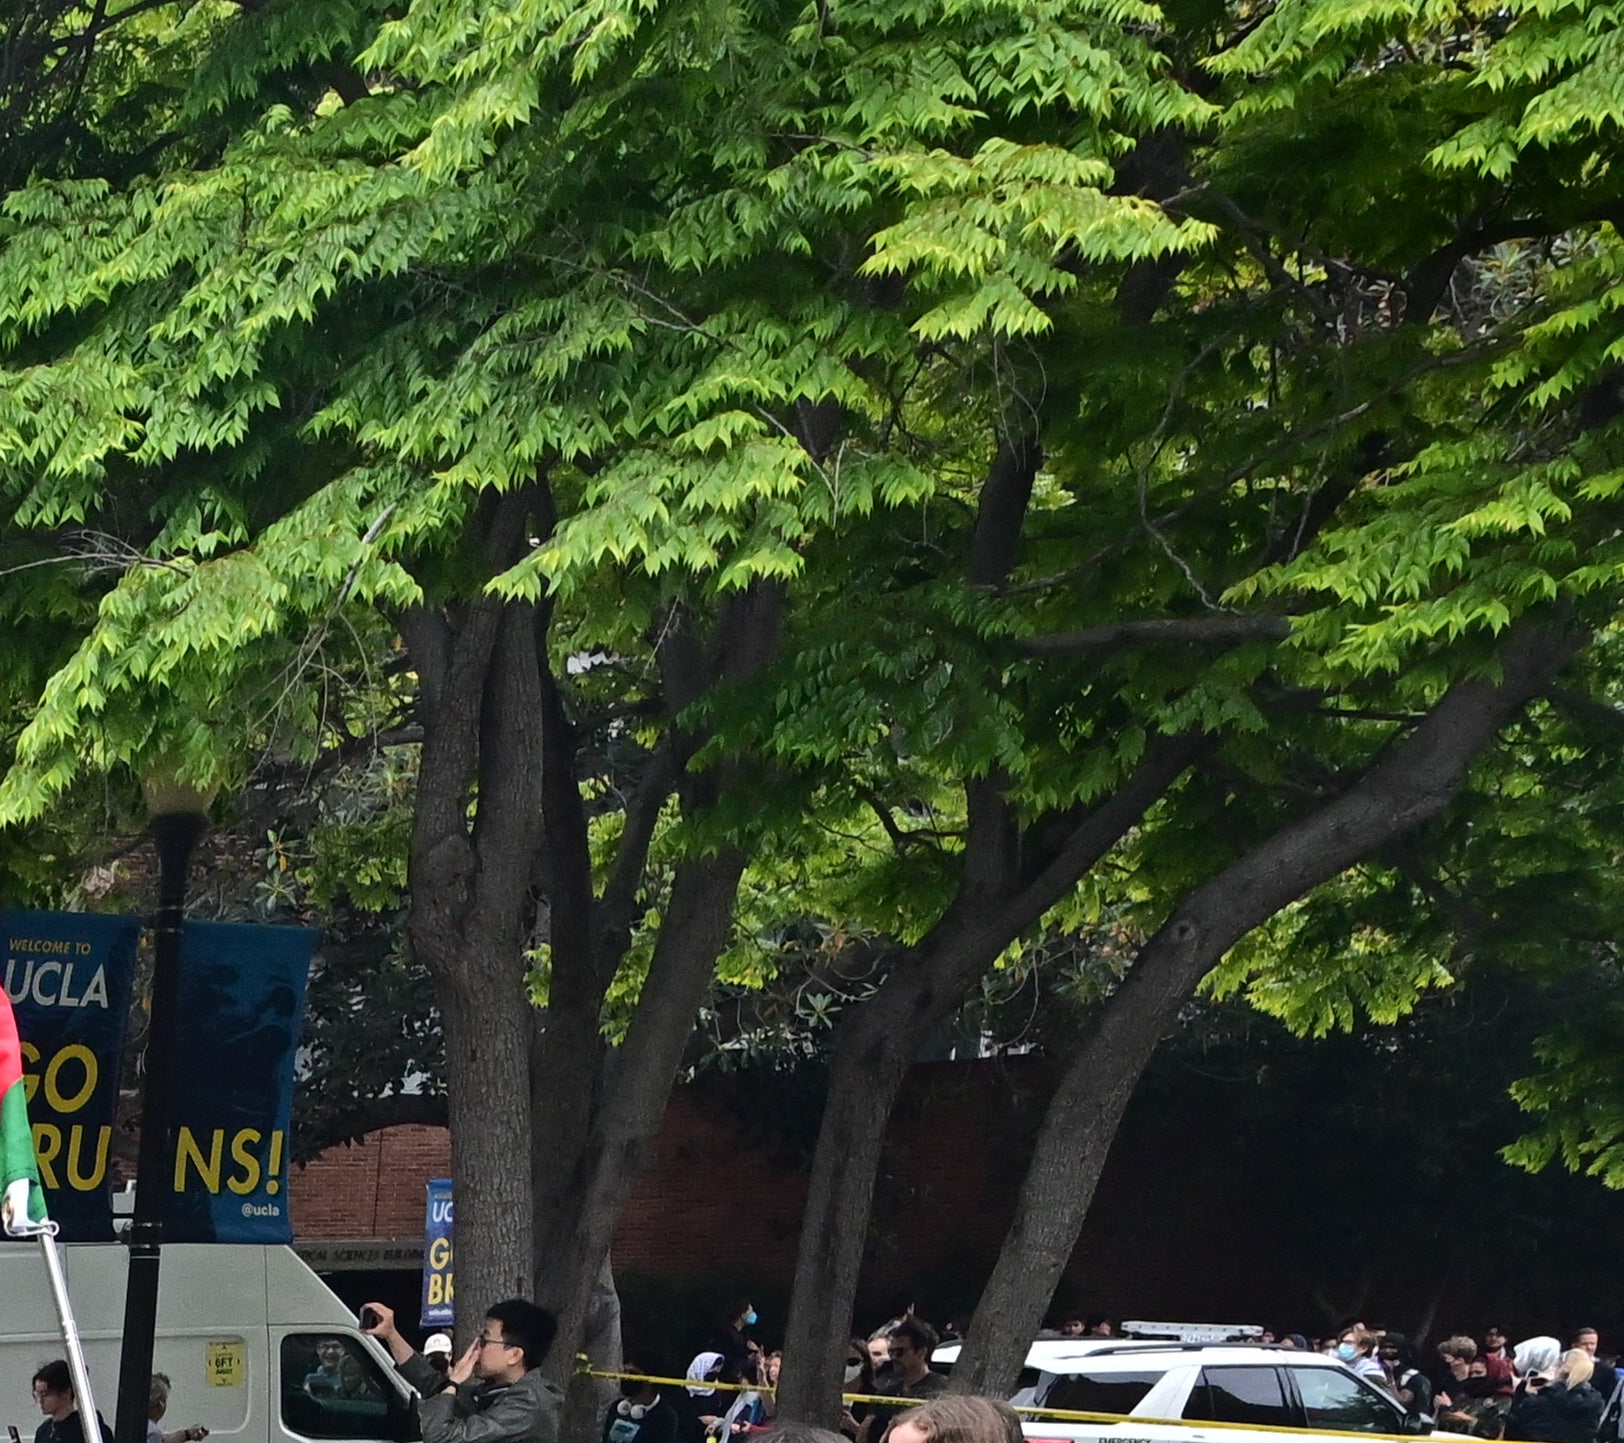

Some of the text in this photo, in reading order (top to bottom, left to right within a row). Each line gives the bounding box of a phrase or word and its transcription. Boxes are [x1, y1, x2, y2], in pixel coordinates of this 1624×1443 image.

[9, 938, 91, 956] WELCOME TO
[3, 959, 109, 1009] UCLA
[32, 1123, 112, 1192] RU
[241, 1203, 280, 1218] @ucla
[432, 1201, 453, 1223] UC
